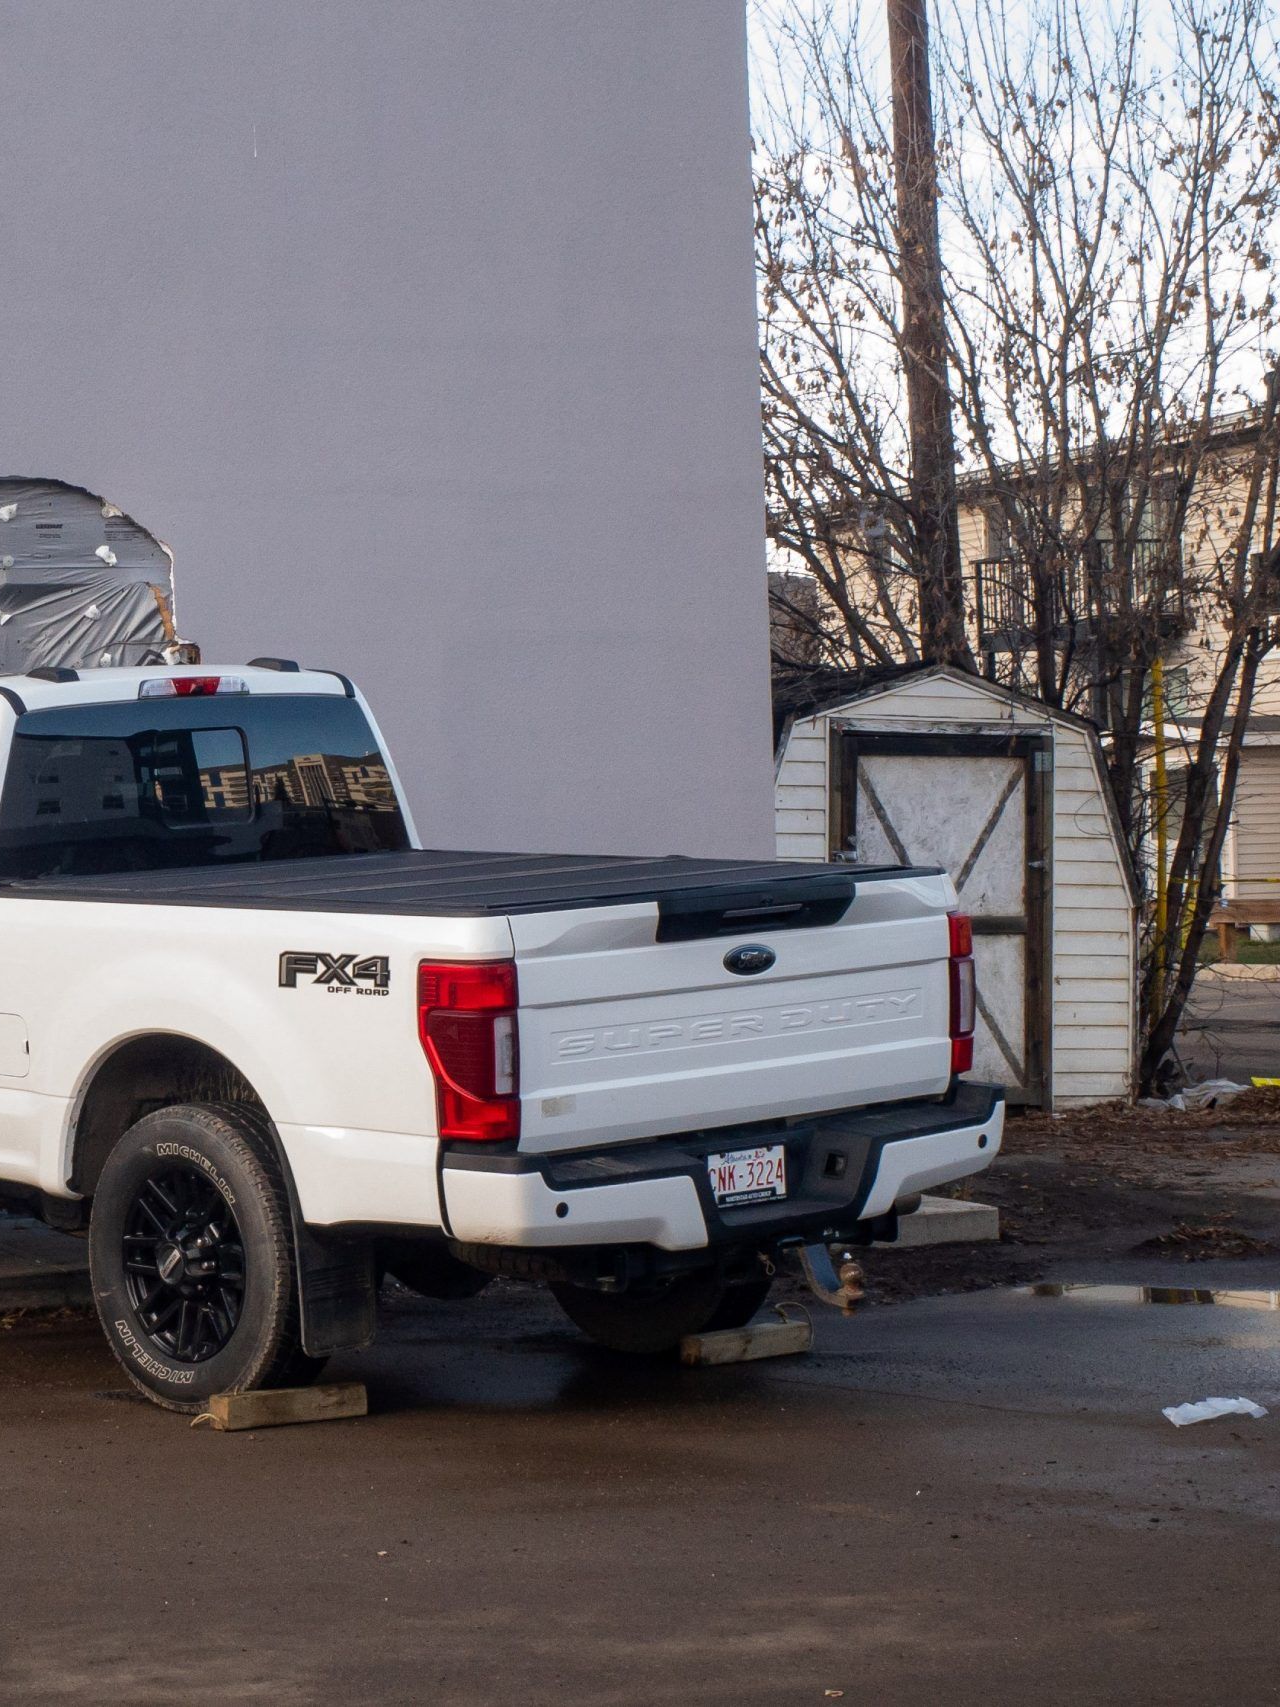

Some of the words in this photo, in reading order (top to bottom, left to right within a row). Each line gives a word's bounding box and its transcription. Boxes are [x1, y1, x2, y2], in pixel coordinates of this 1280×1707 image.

[279, 951, 390, 988] FX4
[327, 986, 351, 994] OFF
[356, 987, 390, 997] ROAD
[558, 1013, 764, 1057] SUPER
[780, 993, 916, 1030] DUTY
[156, 1142, 236, 1204] MICHELIN
[708, 1158, 783, 1192] CNK-3224
[115, 1319, 195, 1384] MICHELIN
